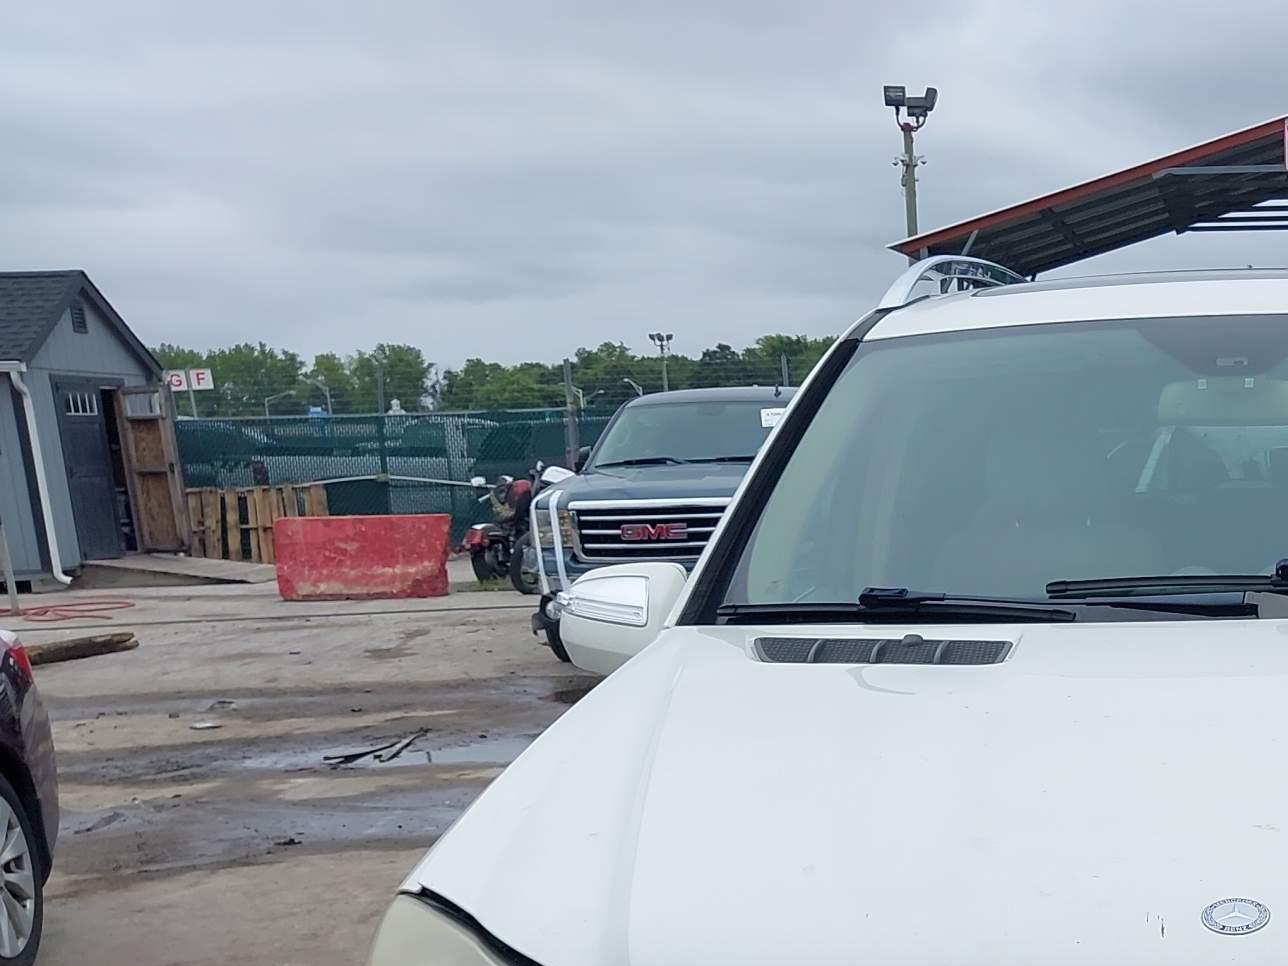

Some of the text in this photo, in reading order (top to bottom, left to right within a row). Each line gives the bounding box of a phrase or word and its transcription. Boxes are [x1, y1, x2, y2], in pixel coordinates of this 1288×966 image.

[170, 373, 183, 387] G
[196, 372, 206, 386] F
[620, 523, 688, 541] GMC
